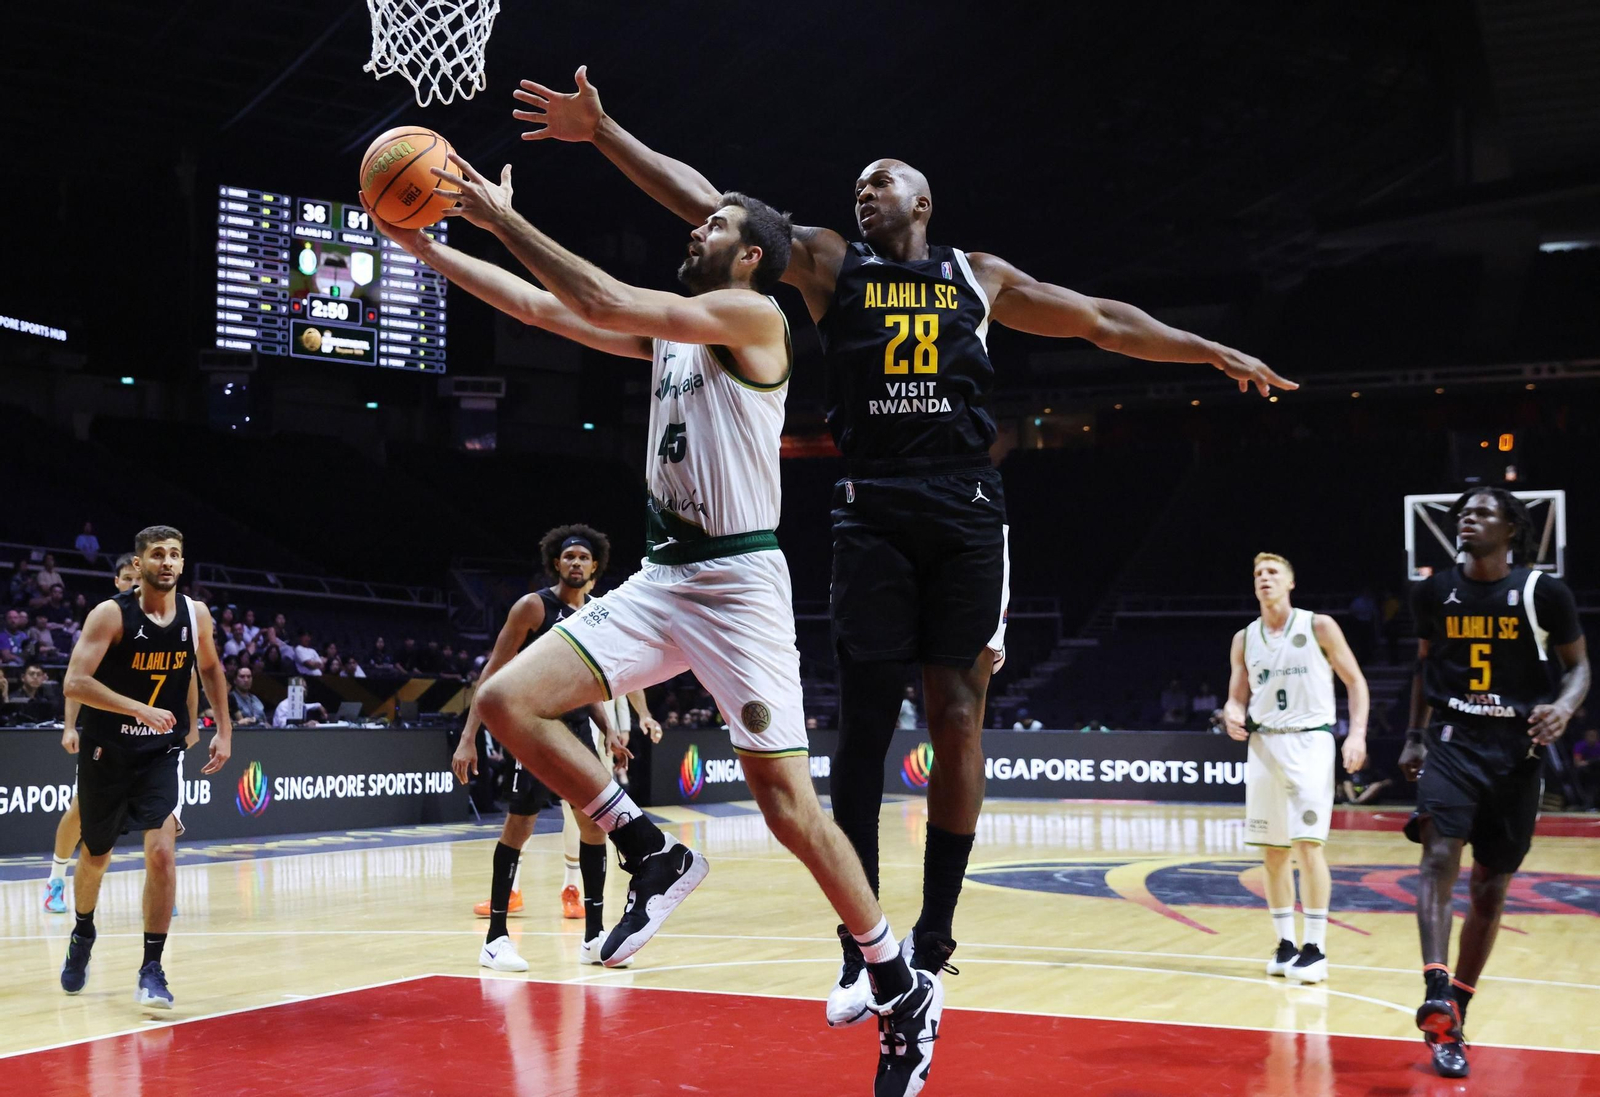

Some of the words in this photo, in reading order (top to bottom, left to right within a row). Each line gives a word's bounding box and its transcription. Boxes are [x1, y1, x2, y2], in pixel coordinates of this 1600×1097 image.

[401, 186, 423, 207] FIBA
[303, 203, 326, 223] 36
[347, 211, 368, 230] 51
[864, 282, 926, 309] ALAHLI
[934, 283, 959, 310] SC
[311, 299, 349, 321] 2:50
[884, 313, 939, 375] 28
[885, 381, 937, 398] VISIT
[868, 397, 953, 415] RWANDA
[657, 421, 687, 464] 45
[588, 611, 602, 625] SOL
[1497, 616, 1519, 640] SC
[131, 651, 172, 671] ALAHLI
[172, 651, 187, 670] SC
[1469, 643, 1492, 691] 5
[147, 674, 167, 707] 7
[1276, 688, 1287, 711] 9
[1464, 692, 1502, 706] VISIT
[1447, 696, 1517, 718] RWANDA
[121, 723, 174, 736] RWAN
[809, 755, 831, 778] HUB
[1099, 759, 1198, 784] SPORTS
[1204, 761, 1248, 785] HU
[273, 774, 366, 802] SINGAPORE
[367, 772, 423, 797] SPORTS
[424, 771, 454, 794] HUB
[0, 784, 76, 815] GAPOR
